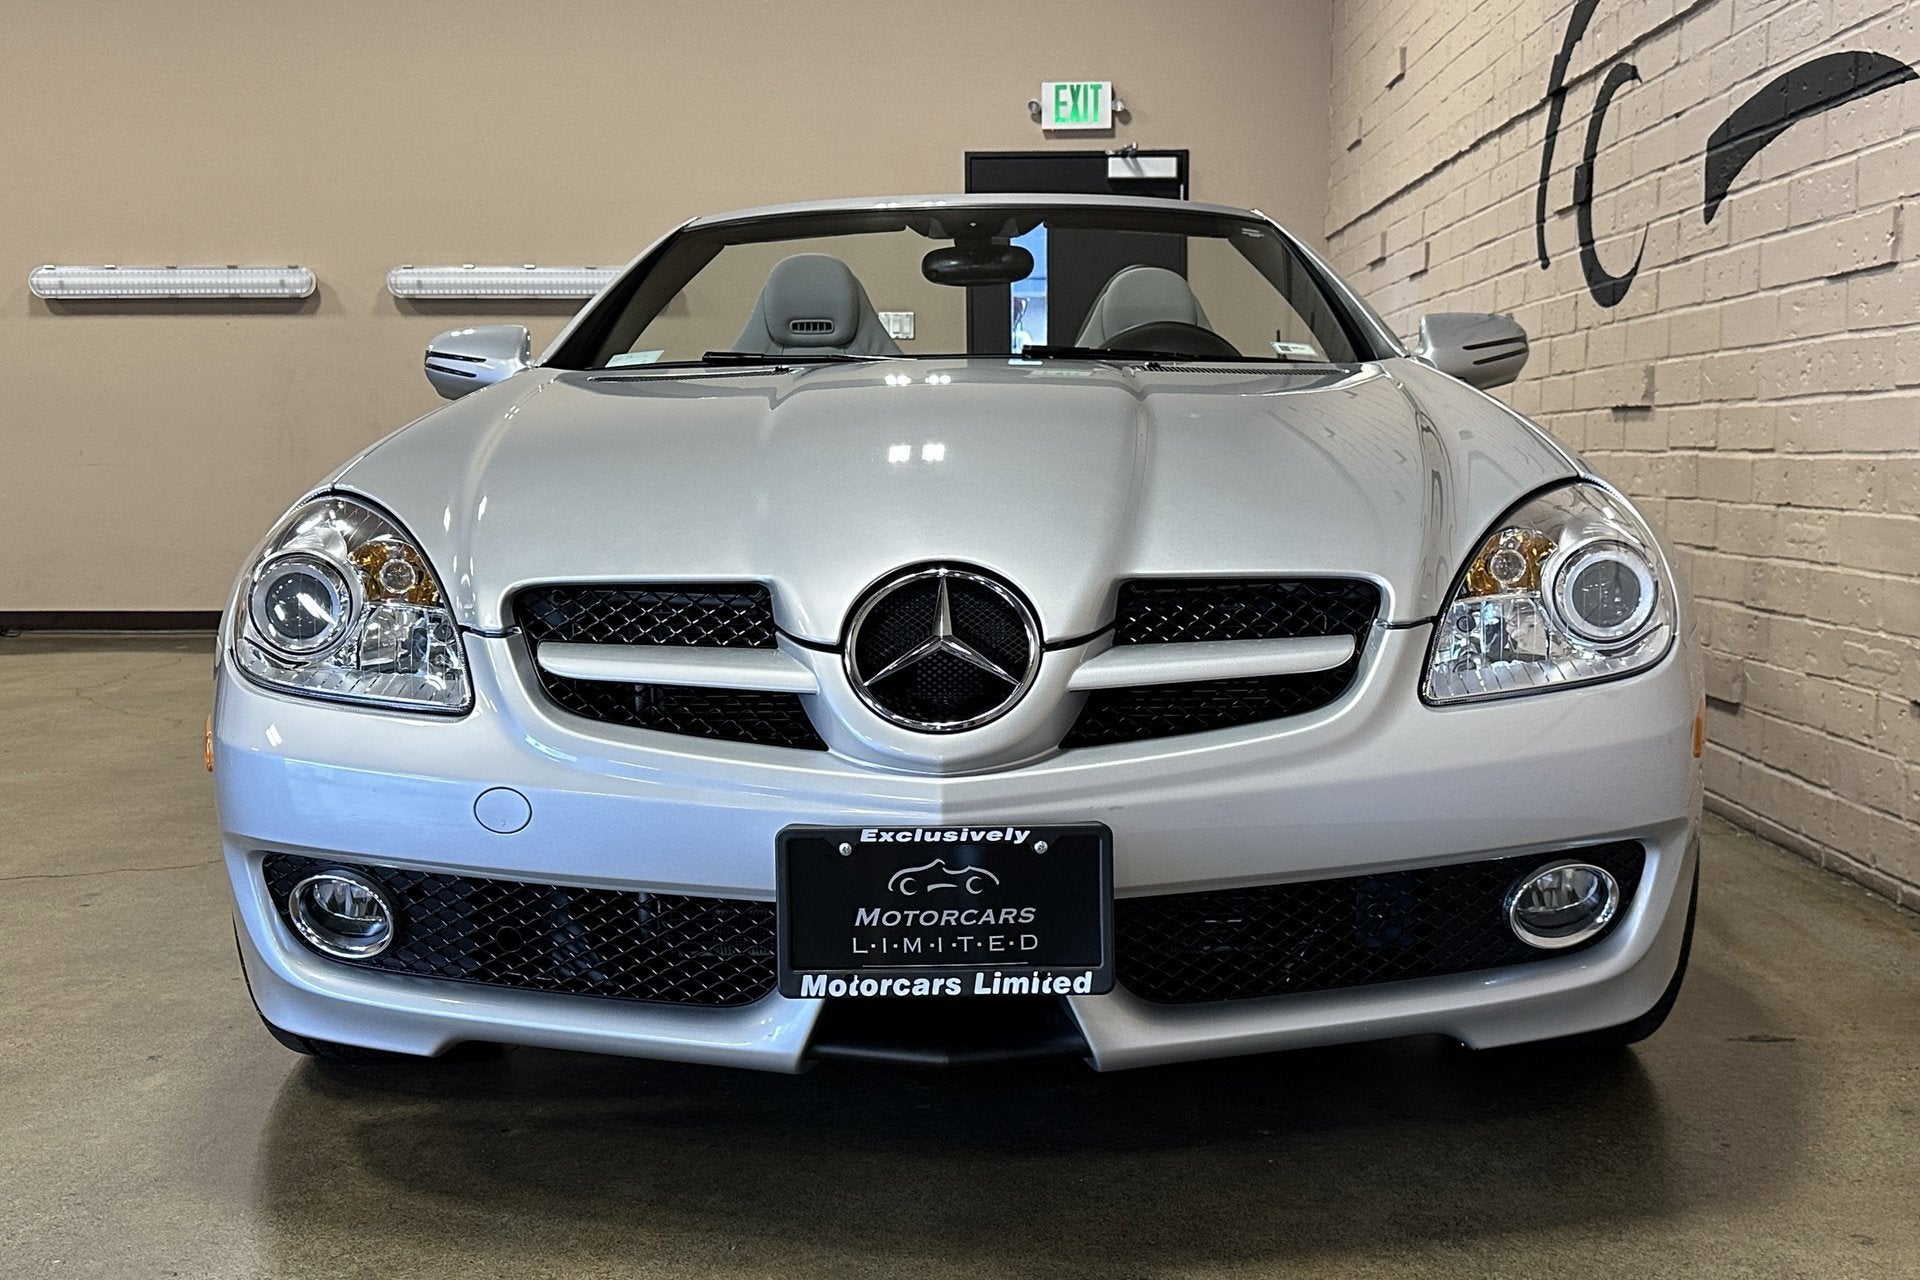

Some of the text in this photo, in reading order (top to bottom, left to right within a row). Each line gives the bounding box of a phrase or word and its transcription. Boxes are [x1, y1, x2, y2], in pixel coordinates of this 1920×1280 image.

[1055, 85, 1102, 123] EXIT
[860, 828, 1031, 844] Exclusively
[855, 907, 1037, 927] MOTORCARS
[800, 971, 1093, 998] Motorcars Limited
